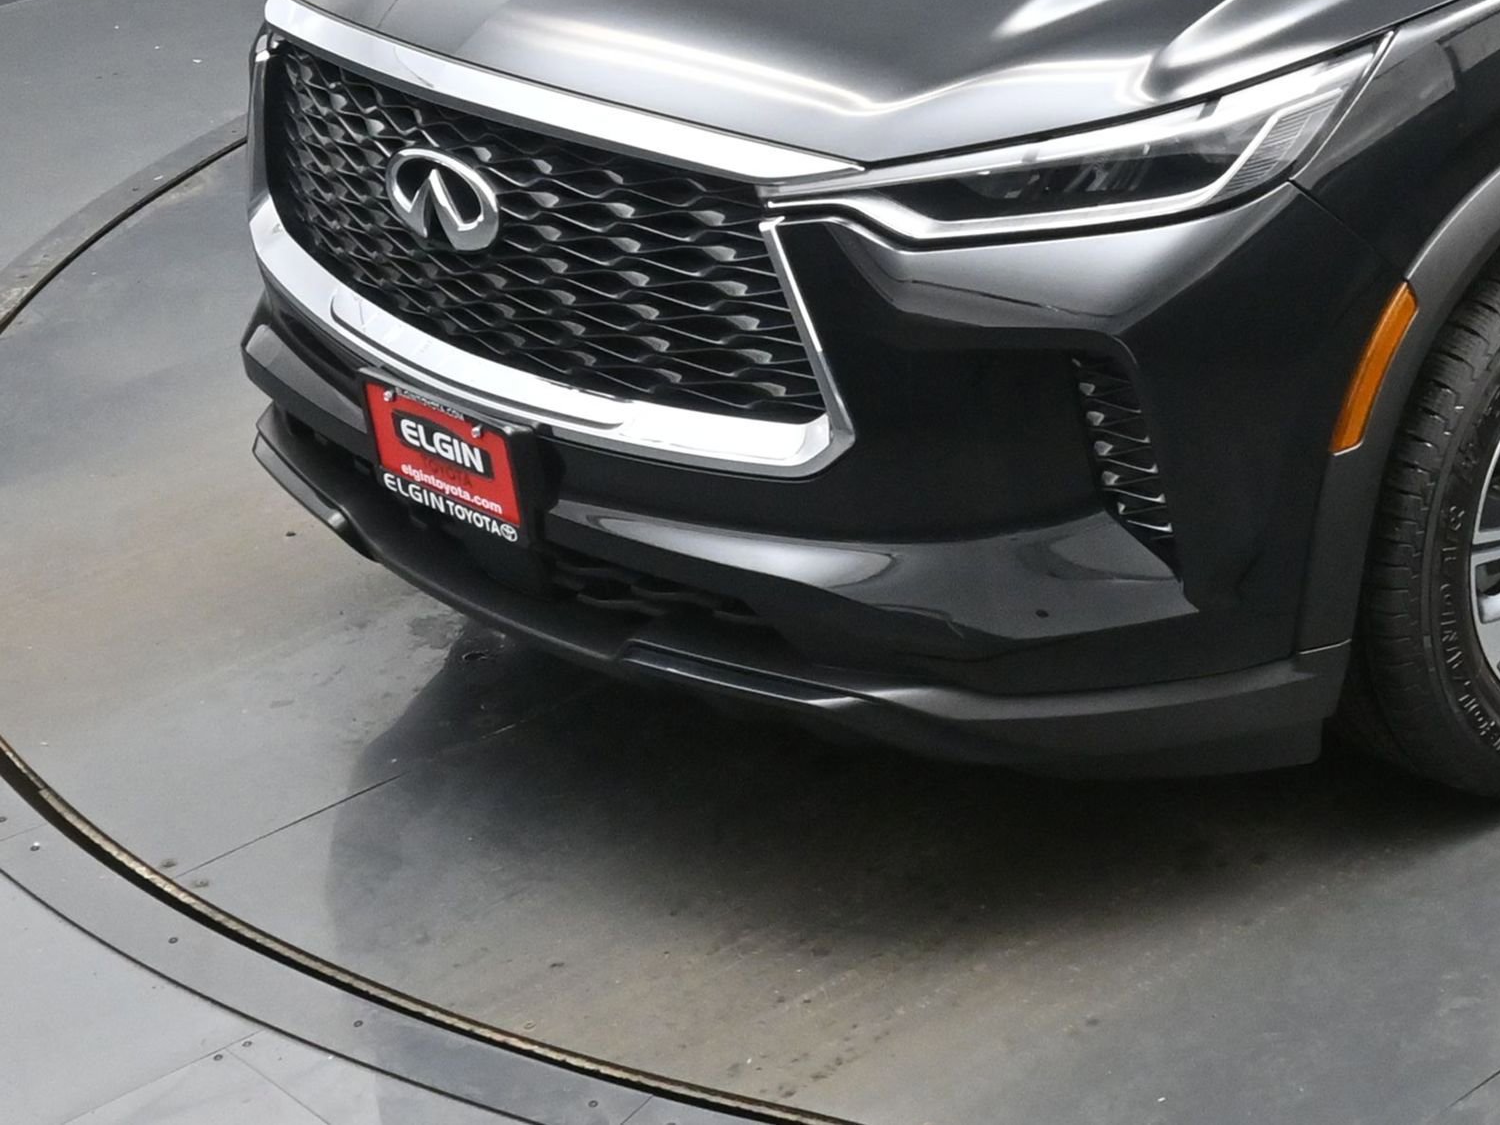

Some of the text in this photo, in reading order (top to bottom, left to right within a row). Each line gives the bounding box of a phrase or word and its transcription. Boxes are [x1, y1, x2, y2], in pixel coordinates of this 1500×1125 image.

[400, 418, 485, 473] ELGIN
[383, 472, 502, 537] ELGIN TOYOTA
[401, 463, 503, 515] elgintoyota.com
